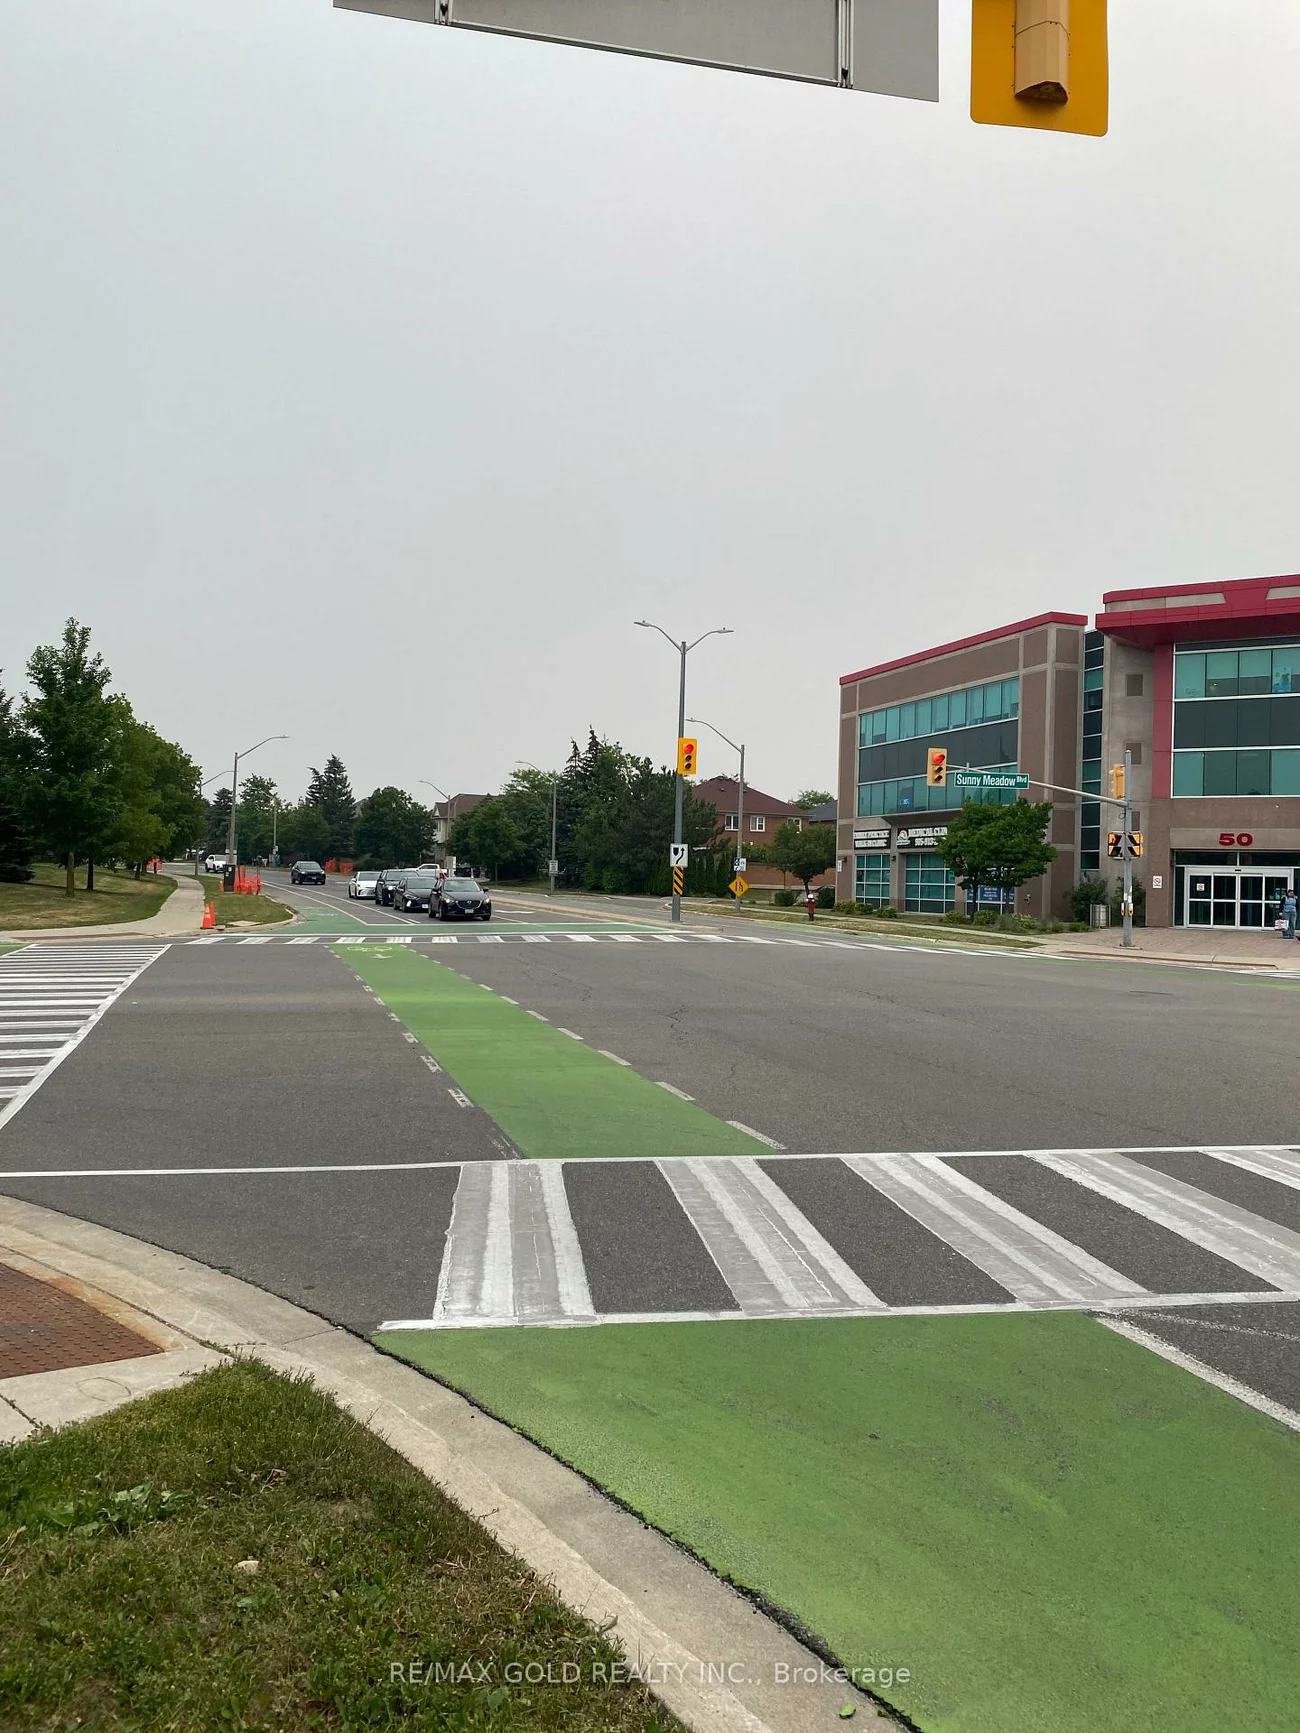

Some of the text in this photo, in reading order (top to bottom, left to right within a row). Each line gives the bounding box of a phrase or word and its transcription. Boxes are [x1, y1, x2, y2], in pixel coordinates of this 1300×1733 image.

[956, 773, 1027, 787] Sunny Meadow Blvd
[1219, 832, 1253, 847] 50
